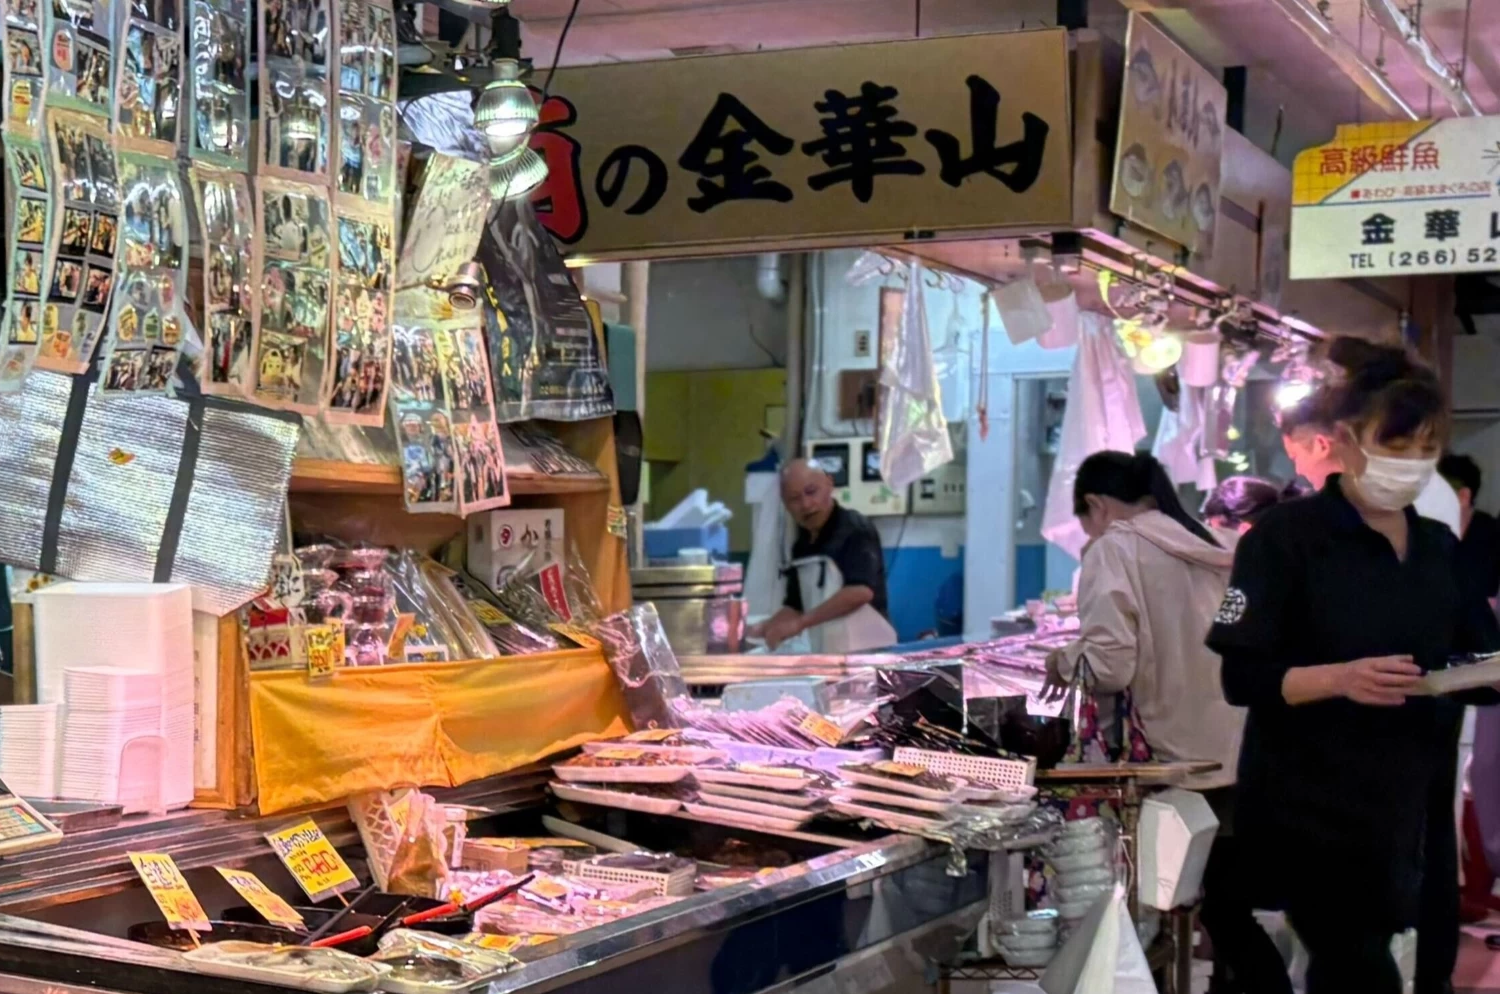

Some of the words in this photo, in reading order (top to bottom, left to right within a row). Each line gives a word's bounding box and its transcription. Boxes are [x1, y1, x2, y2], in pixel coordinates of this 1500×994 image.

[1320, 142, 1440, 176] 高級鮮魚
[1350, 253, 1375, 268] TEL
